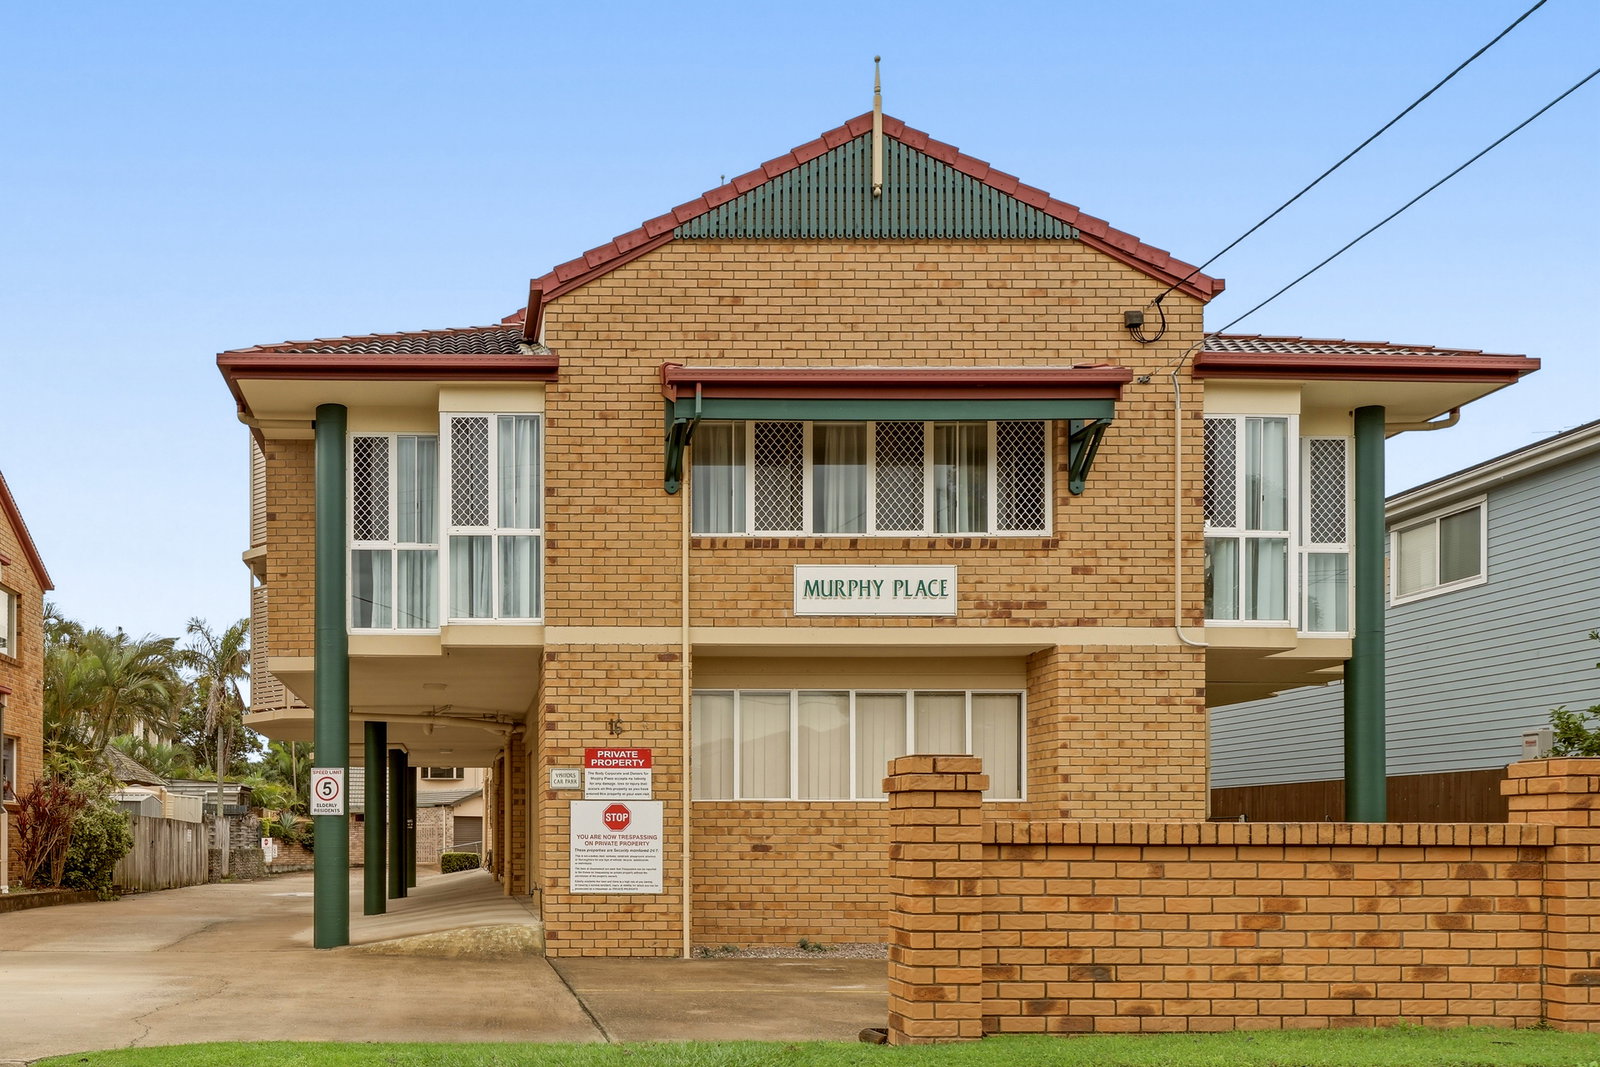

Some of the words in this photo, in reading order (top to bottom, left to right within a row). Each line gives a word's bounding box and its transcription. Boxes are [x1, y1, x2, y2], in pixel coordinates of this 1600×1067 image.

[803, 579, 884, 600] MURPHY
[892, 579, 949, 600] PLACE
[597, 750, 639, 758] PRIVATE
[591, 759, 645, 767] PROPERTY
[322, 782, 332, 796] 5
[606, 813, 628, 822] STOP
